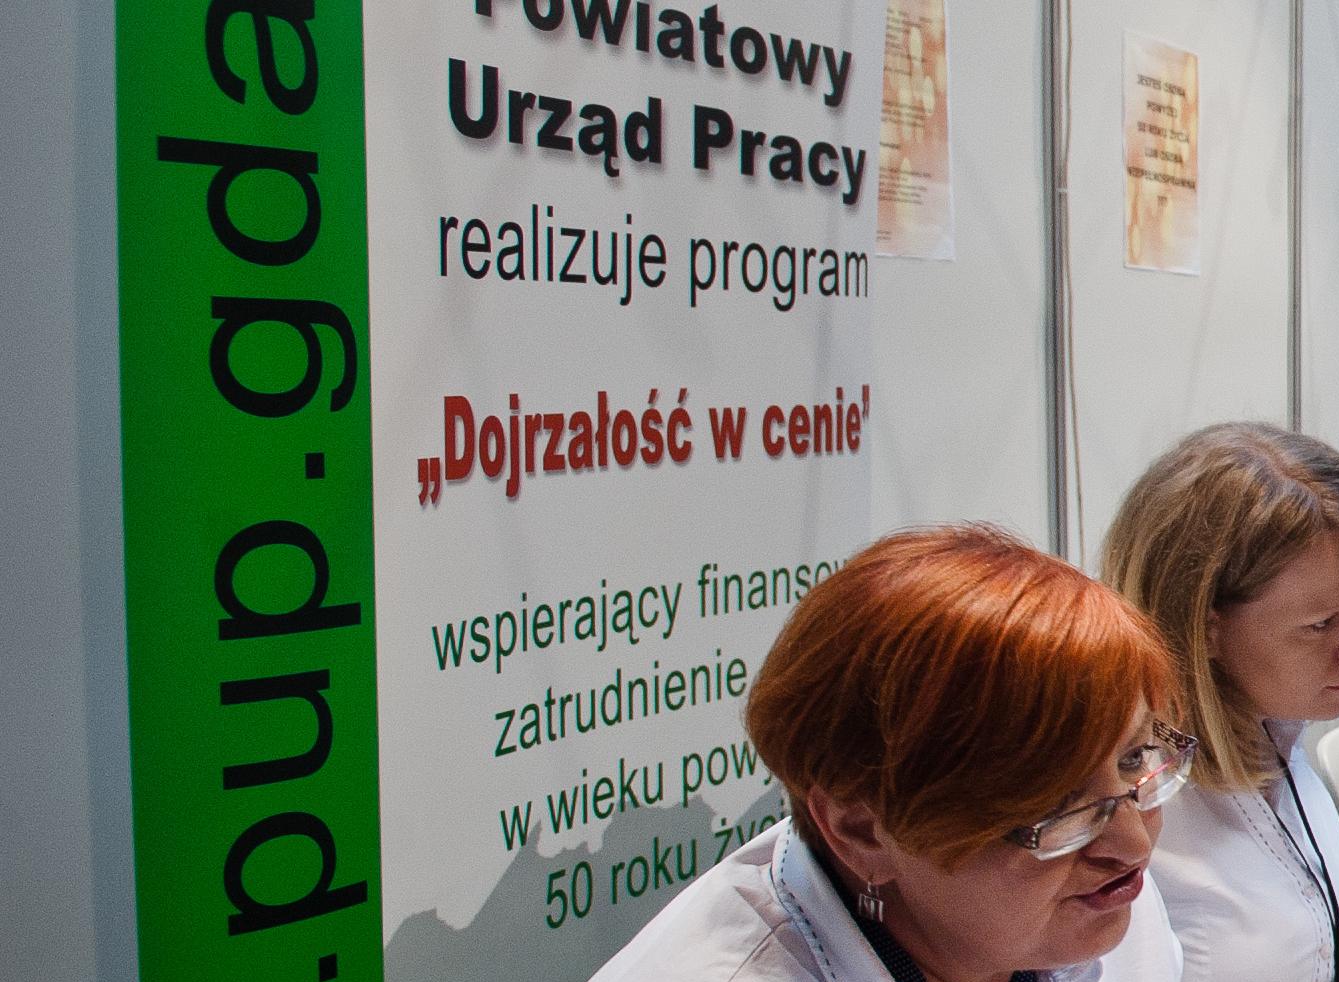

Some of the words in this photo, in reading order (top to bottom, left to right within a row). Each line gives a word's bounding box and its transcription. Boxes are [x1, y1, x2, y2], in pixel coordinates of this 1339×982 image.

[475, 0, 852, 107] owiatowy
[448, 57, 662, 178] Urząd
[693, 104, 867, 205] Pracy
[439, 204, 667, 306] realizuje
[690, 235, 869, 311] program
[417, 387, 693, 505] „Dojrzałość
[709, 407, 747, 459] w
[432, 579, 682, 673] wspierający
[494, 649, 748, 757] zatrudnienie
[500, 801, 532, 851] w
[547, 758, 664, 835] wieku
[545, 860, 593, 929] 50
[610, 836, 697, 905] roku
